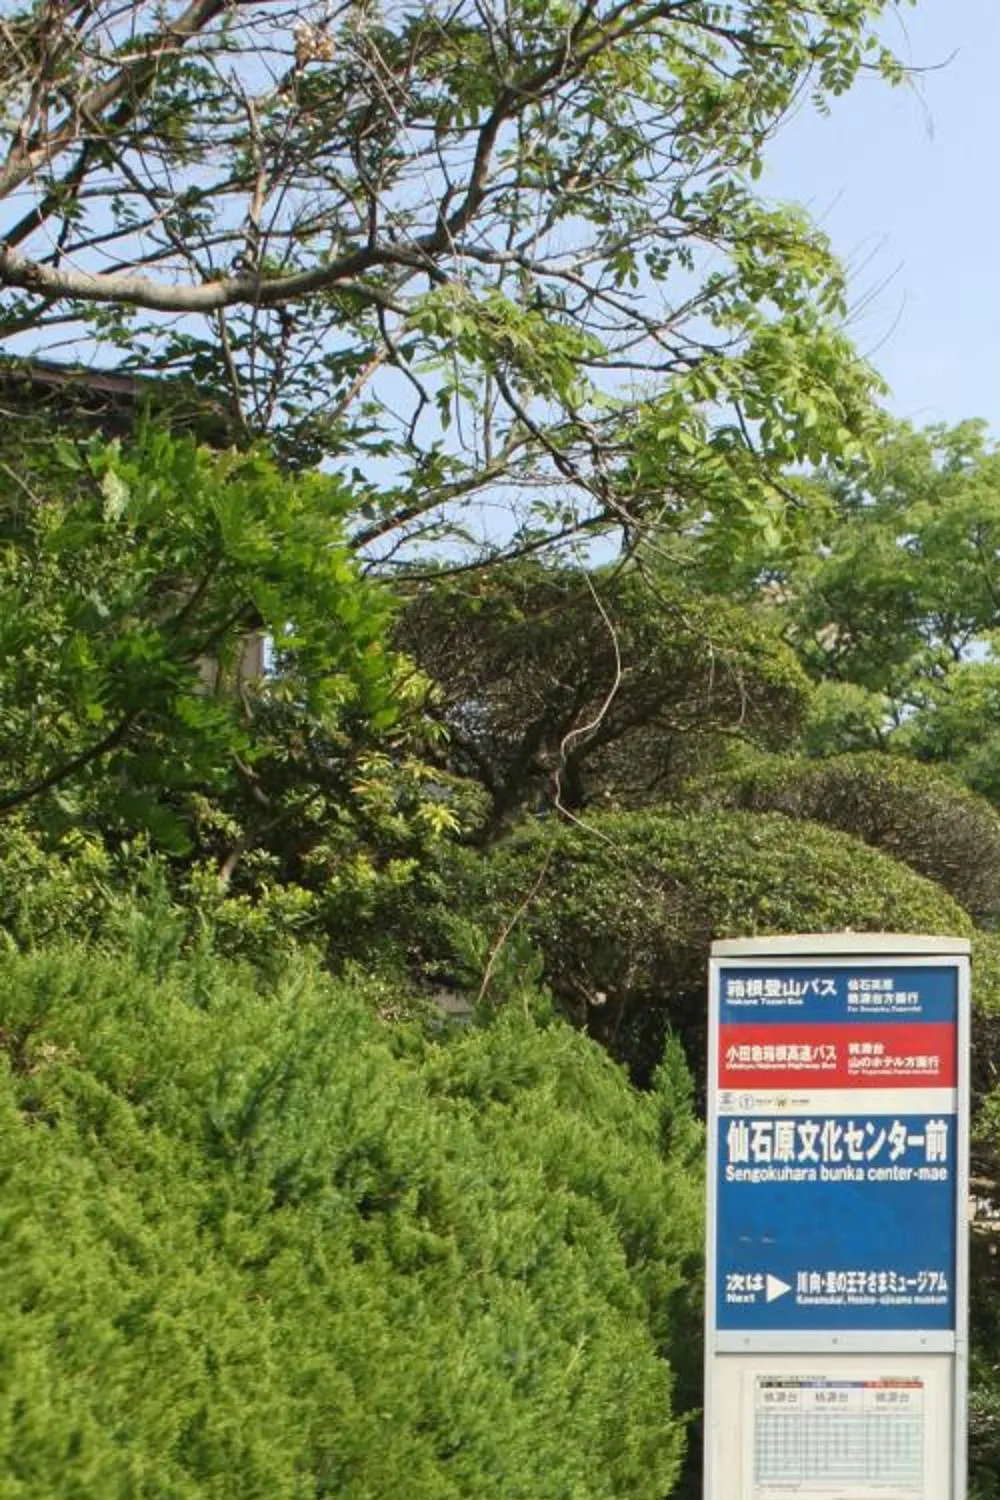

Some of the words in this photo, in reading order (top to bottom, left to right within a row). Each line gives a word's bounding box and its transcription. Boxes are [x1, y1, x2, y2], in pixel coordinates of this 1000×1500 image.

[726, 978, 837, 997] 箱根登山バス
[726, 1045, 837, 1062] 小田急箱根高速バス
[727, 1119, 948, 1163] 仙石原文化センター前
[725, 1165, 816, 1183] Sengokuhara
[820, 1165, 864, 1181] bunka
[867, 1166, 948, 1181] center-mae
[725, 1273, 765, 1291] 次は
[727, 1293, 756, 1303] Next
